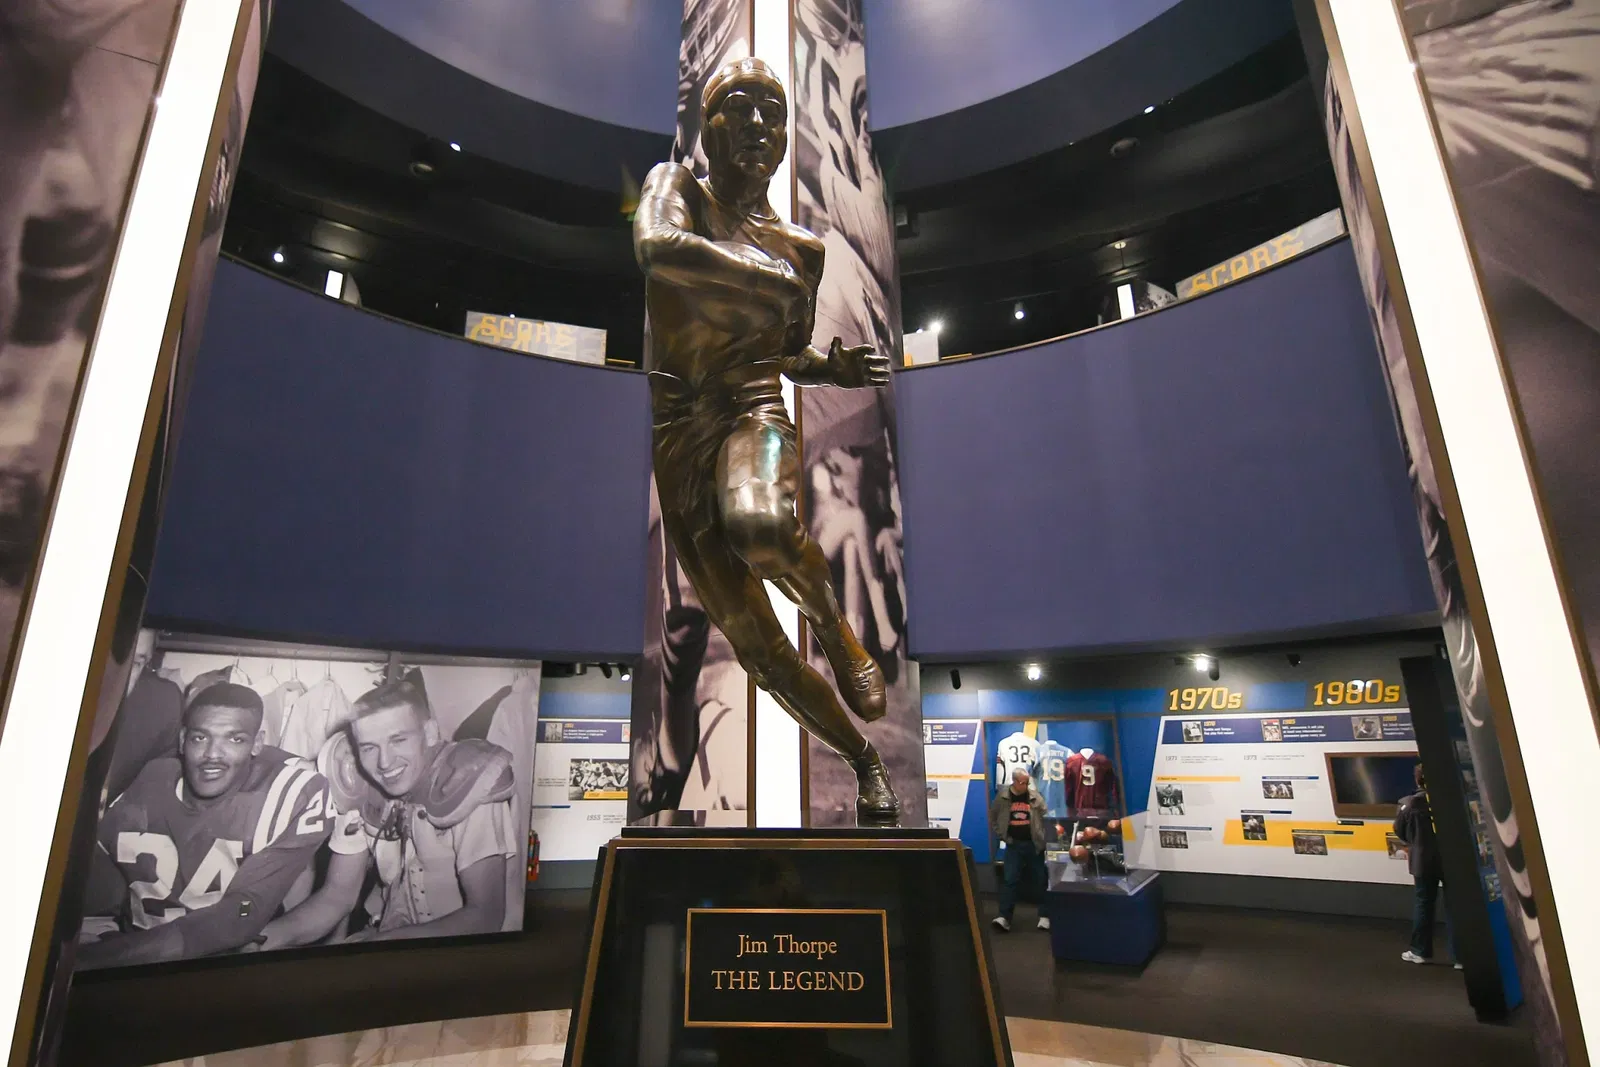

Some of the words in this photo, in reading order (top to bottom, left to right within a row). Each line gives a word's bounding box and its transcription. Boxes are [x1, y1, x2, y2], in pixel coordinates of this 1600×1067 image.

[1169, 687, 1242, 711] 1970s
[1313, 679, 1400, 706] 1980s
[1008, 745, 1030, 763] 32
[1042, 758, 1065, 782] 19
[1082, 764, 1096, 786] 9
[736, 935, 768, 957] Jim
[773, 933, 838, 960] Thorpe
[711, 970, 761, 990] THE
[768, 971, 864, 991] LEGEND
